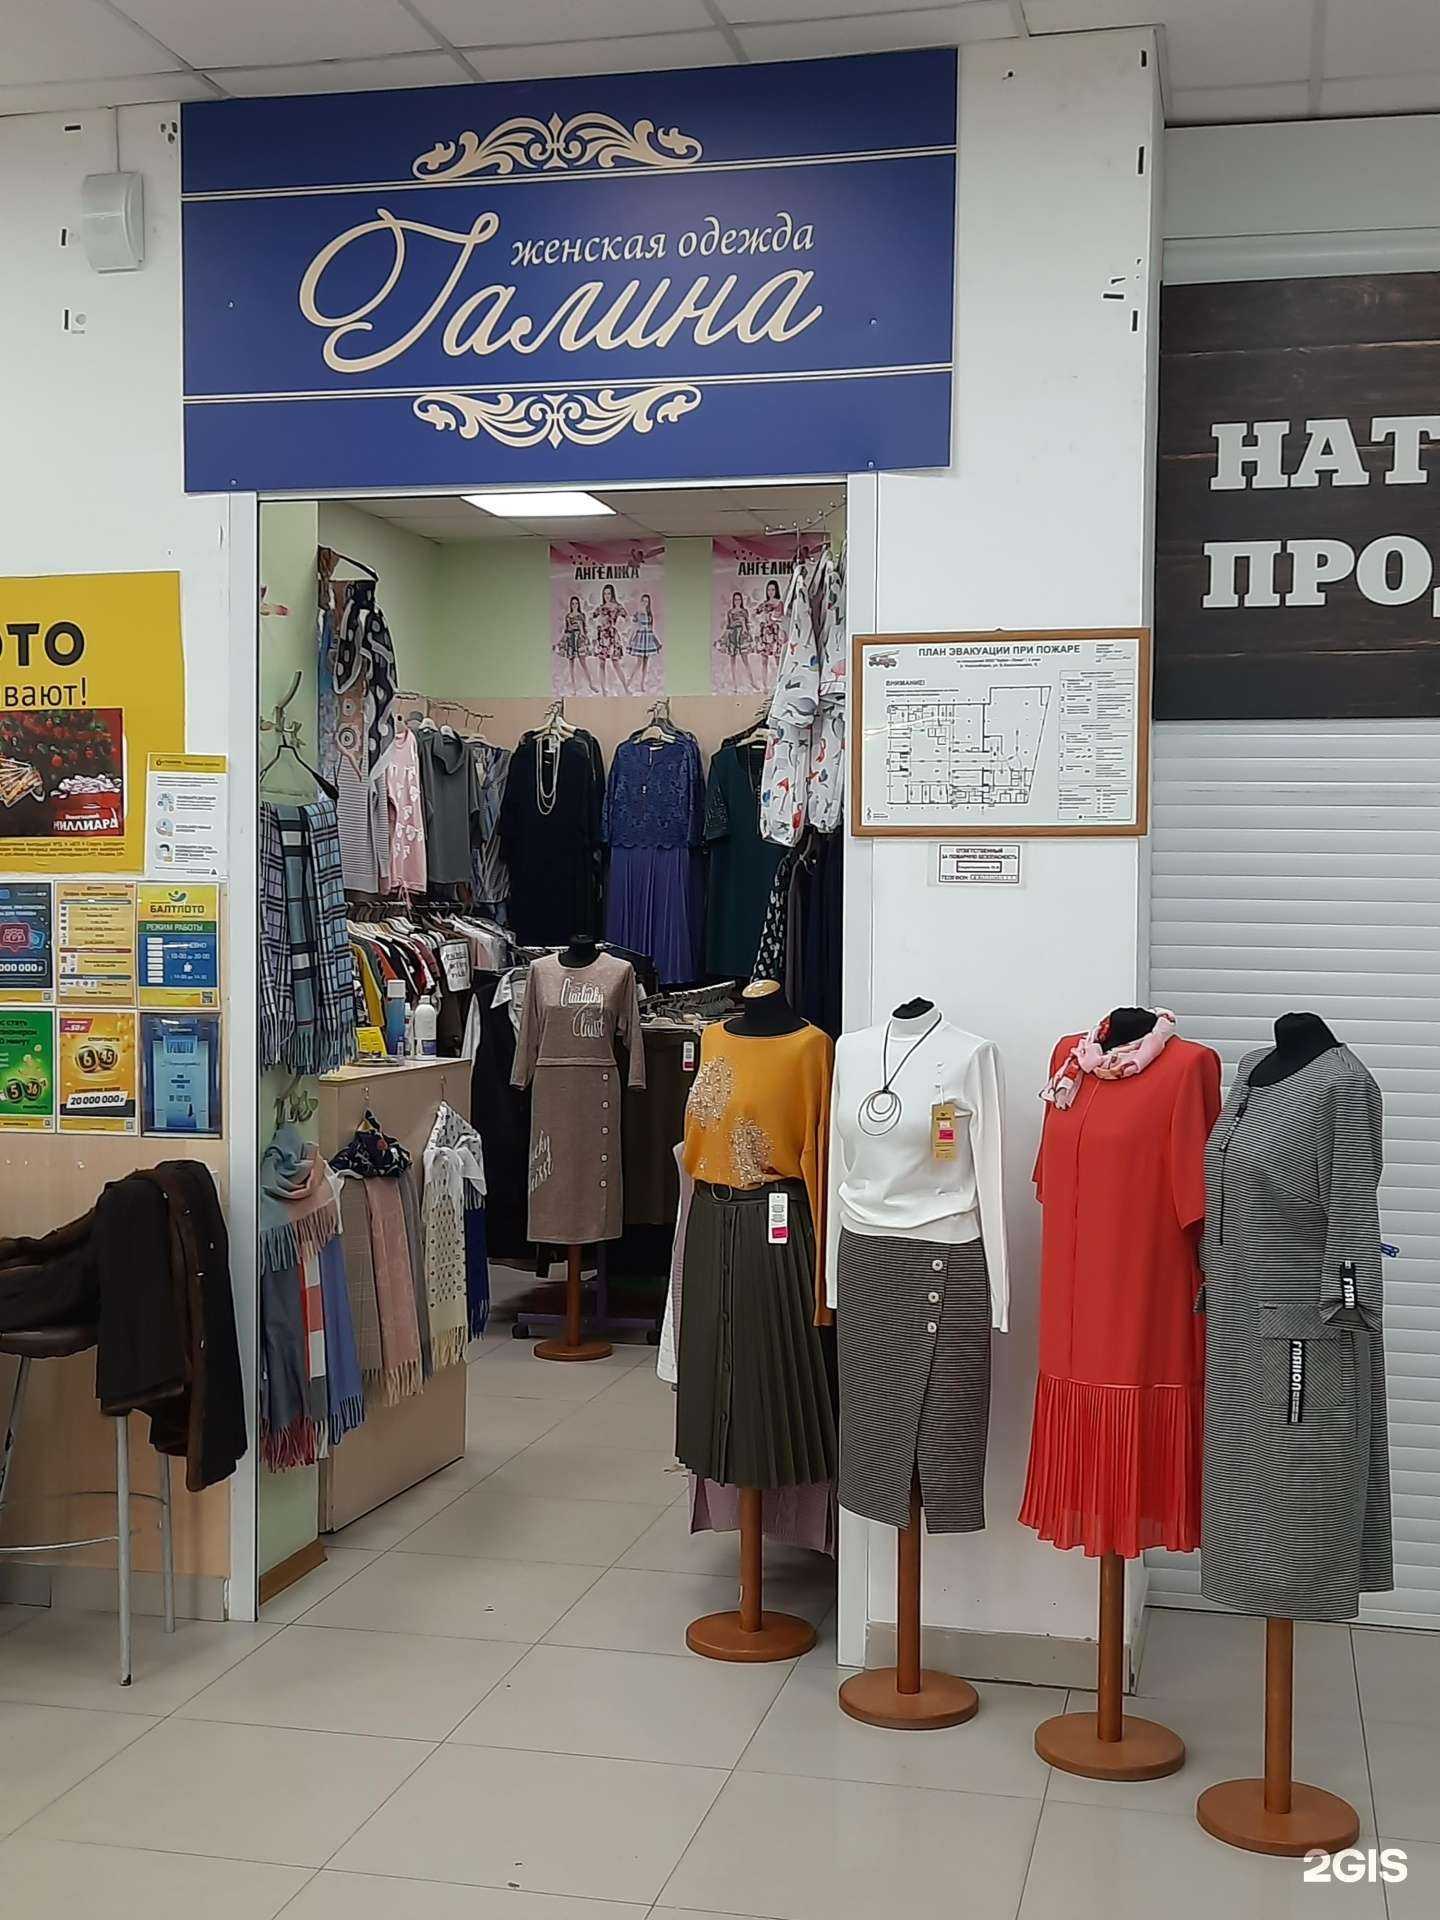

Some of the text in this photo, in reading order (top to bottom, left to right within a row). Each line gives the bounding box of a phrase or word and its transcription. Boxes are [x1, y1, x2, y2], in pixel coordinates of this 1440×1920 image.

[510, 211, 815, 267] женская одежда
[299, 206, 824, 374] Галина
[1210, 415, 1440, 490] НАТ
[1202, 535, 1440, 618] ПРО
[0, 621, 85, 667] ТО
[918, 645, 1080, 656] ПЛАН ЭВАКУАЦИИ ПРИ ПОЖАРЕ
[5, 677, 86, 707] вают!
[150, 905, 205, 914] БАЛТЛОТО
